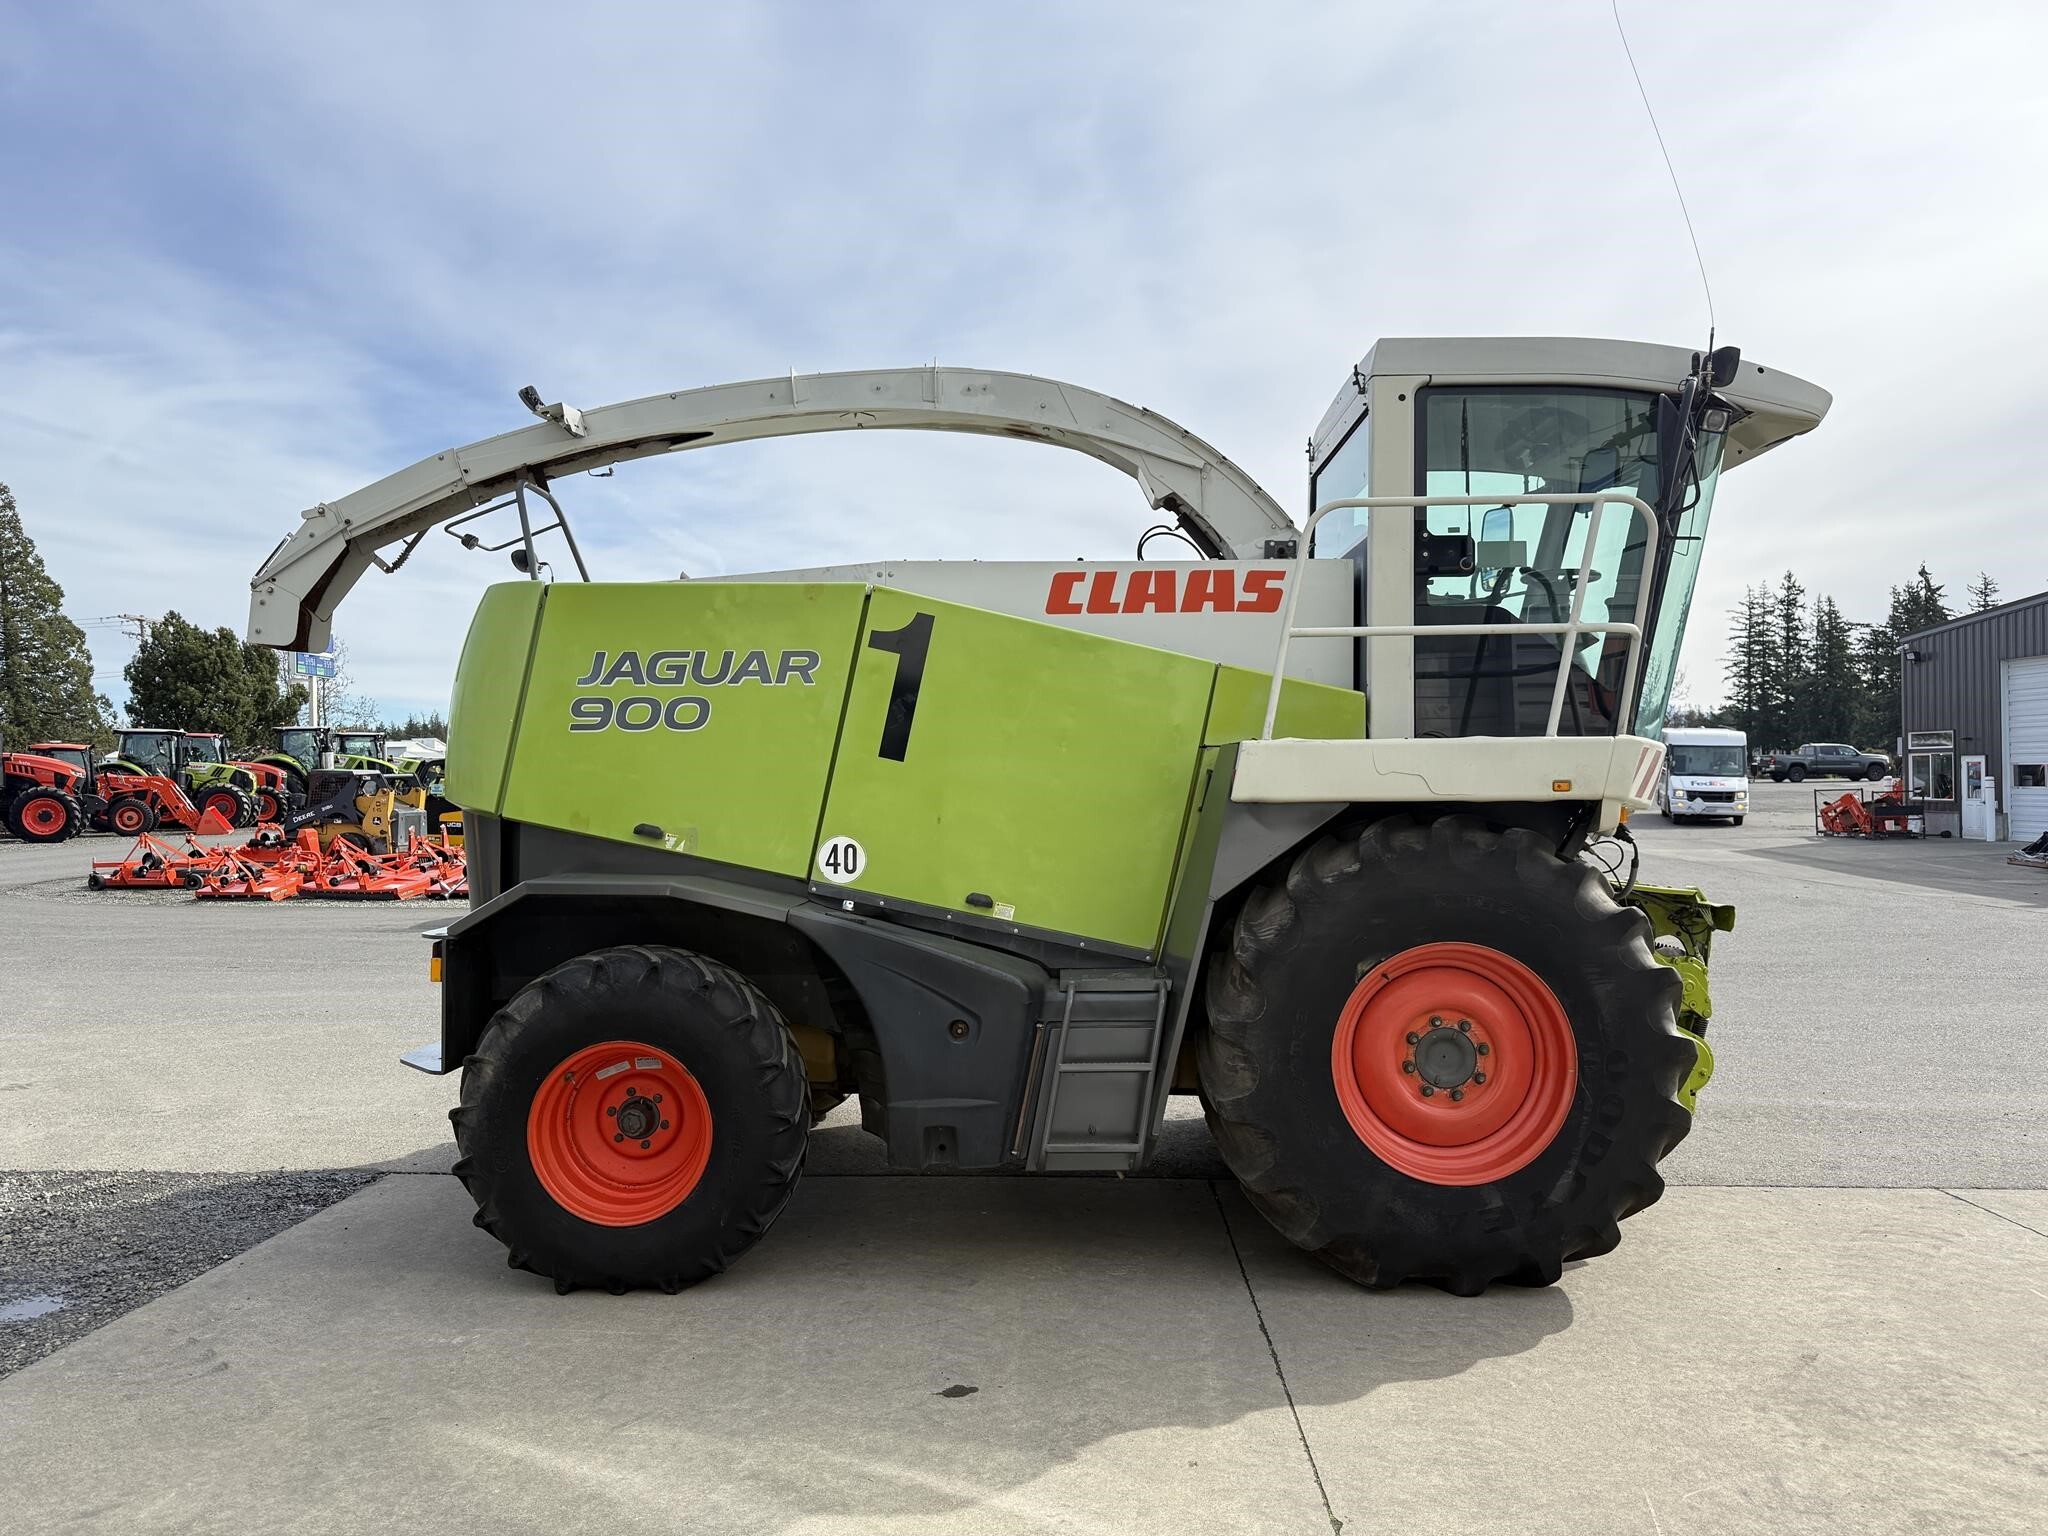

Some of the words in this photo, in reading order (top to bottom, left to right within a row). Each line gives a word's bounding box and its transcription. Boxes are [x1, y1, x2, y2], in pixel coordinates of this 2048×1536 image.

[1045, 569, 1287, 615] CLAAS
[576, 649, 821, 686] JAGUAR
[868, 612, 935, 762] 1
[568, 696, 712, 732] 900
[292, 810, 316, 823] DEERE
[825, 843, 858, 875] 40
